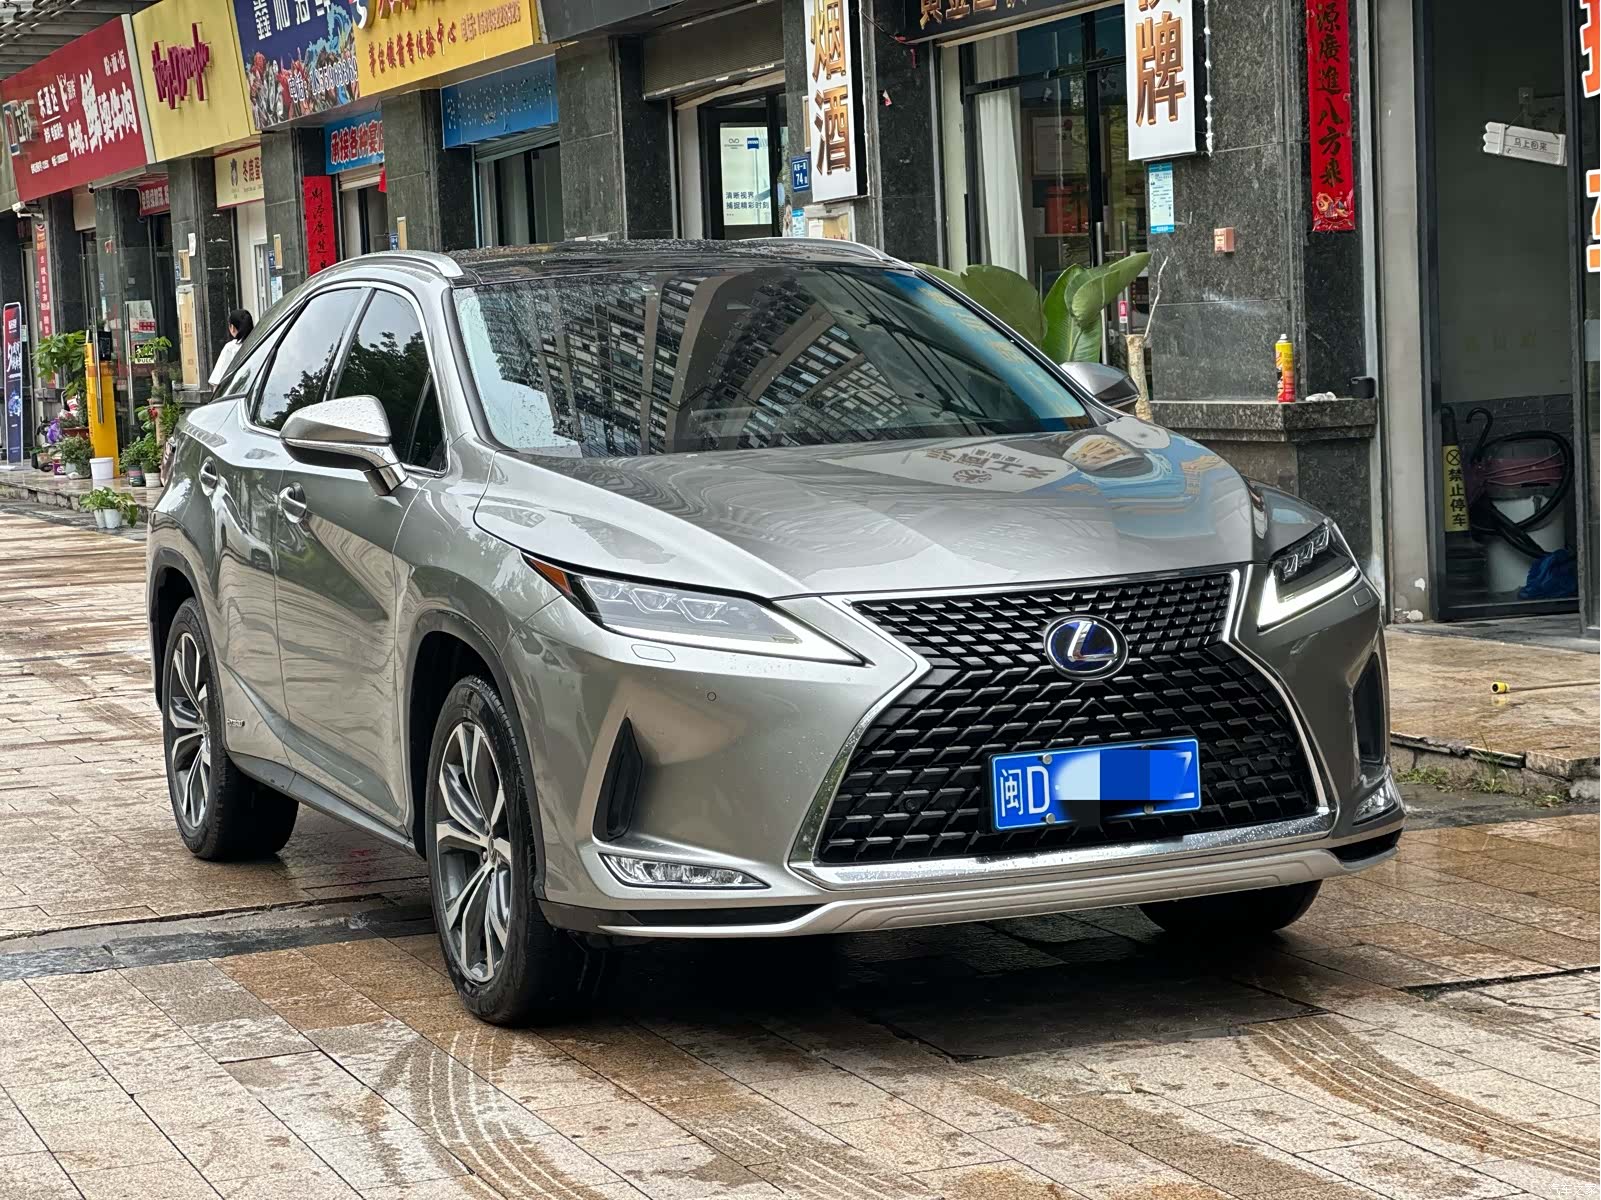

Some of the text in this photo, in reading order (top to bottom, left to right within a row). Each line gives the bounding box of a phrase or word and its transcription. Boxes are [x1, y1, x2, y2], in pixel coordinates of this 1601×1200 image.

[811, 0, 851, 175] 烟酒
[1135, 0, 1186, 127] 牌
[1513, 138, 1547, 151] 马上回来
[726, 202, 769, 210] 捕捉精彩时刻
[1448, 468, 1467, 527] 禁止停车
